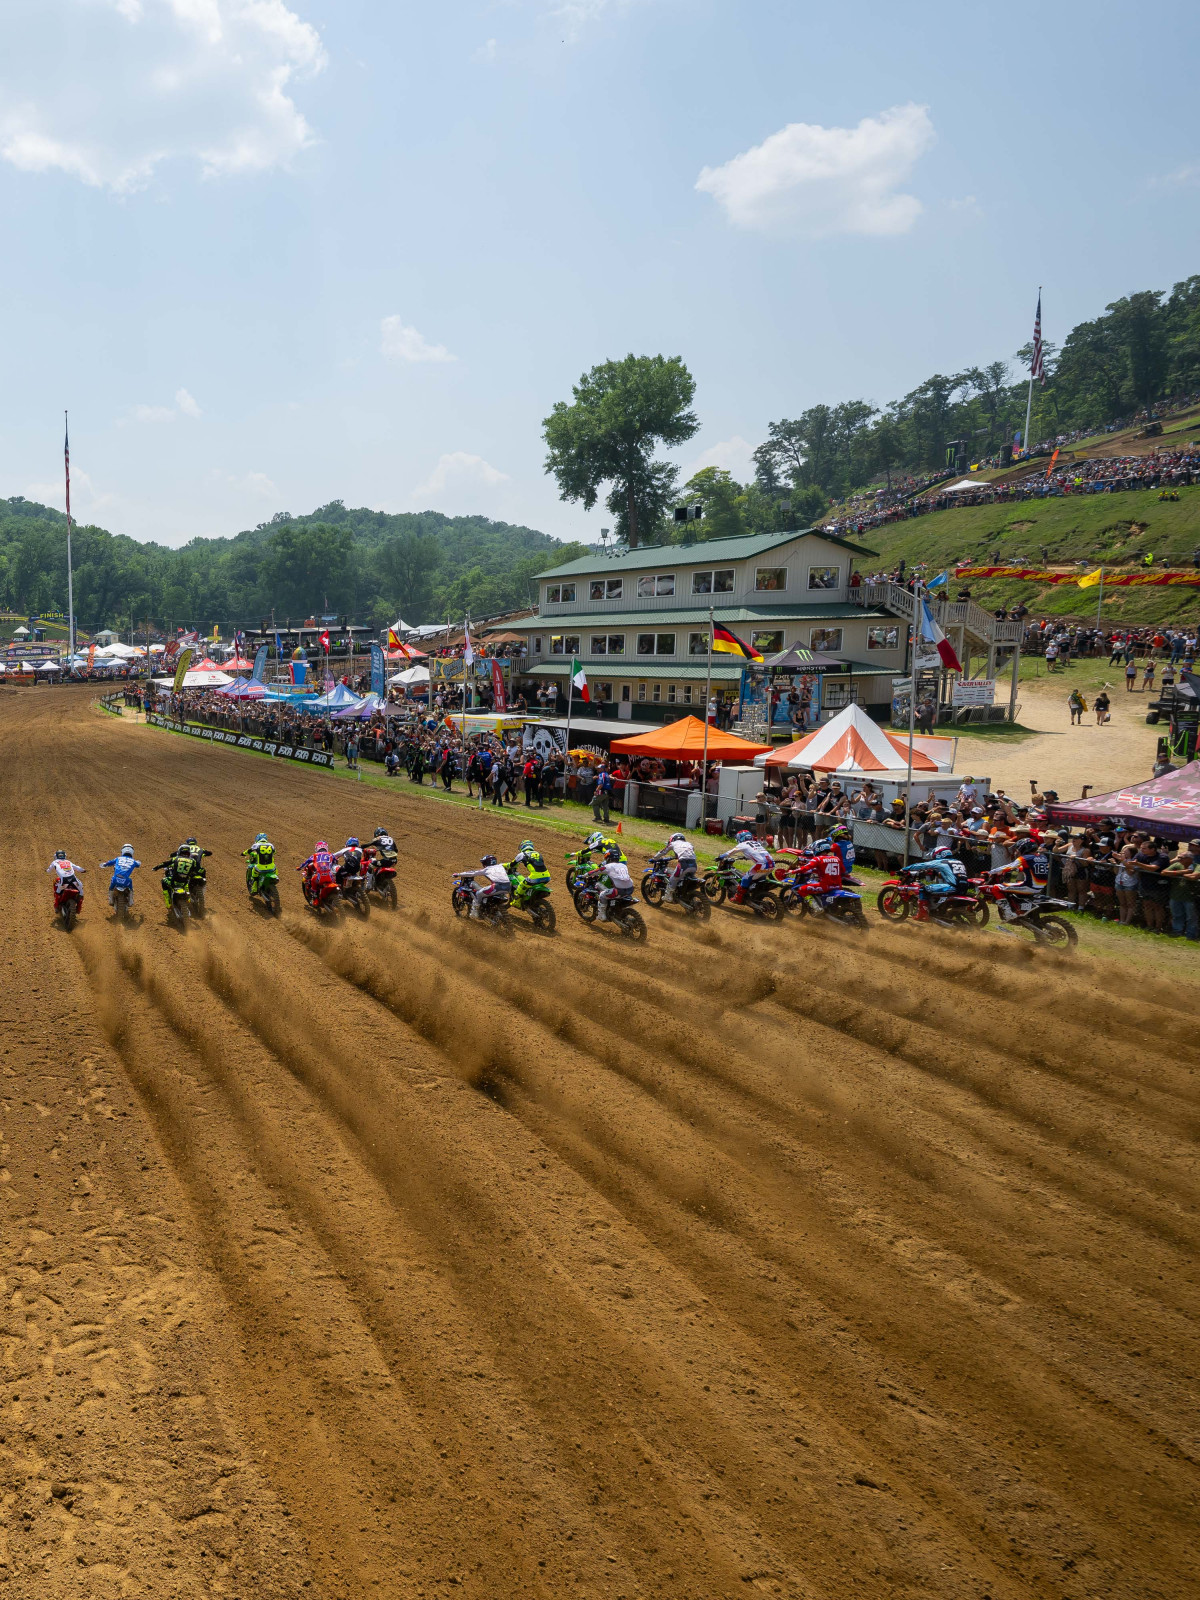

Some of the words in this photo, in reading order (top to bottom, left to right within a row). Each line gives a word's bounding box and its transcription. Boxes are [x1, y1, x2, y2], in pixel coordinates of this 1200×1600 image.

[495, 670, 504, 707] ATM
[213, 731, 224, 740] FXR
[238, 736, 252, 746] FXR
[278, 746, 293, 756] FXR
[294, 749, 309, 760] FXR
[312, 753, 327, 764] FXR
[259, 845, 272, 855] 56
[177, 861, 192, 874] 83
[824, 863, 840, 875] 451
